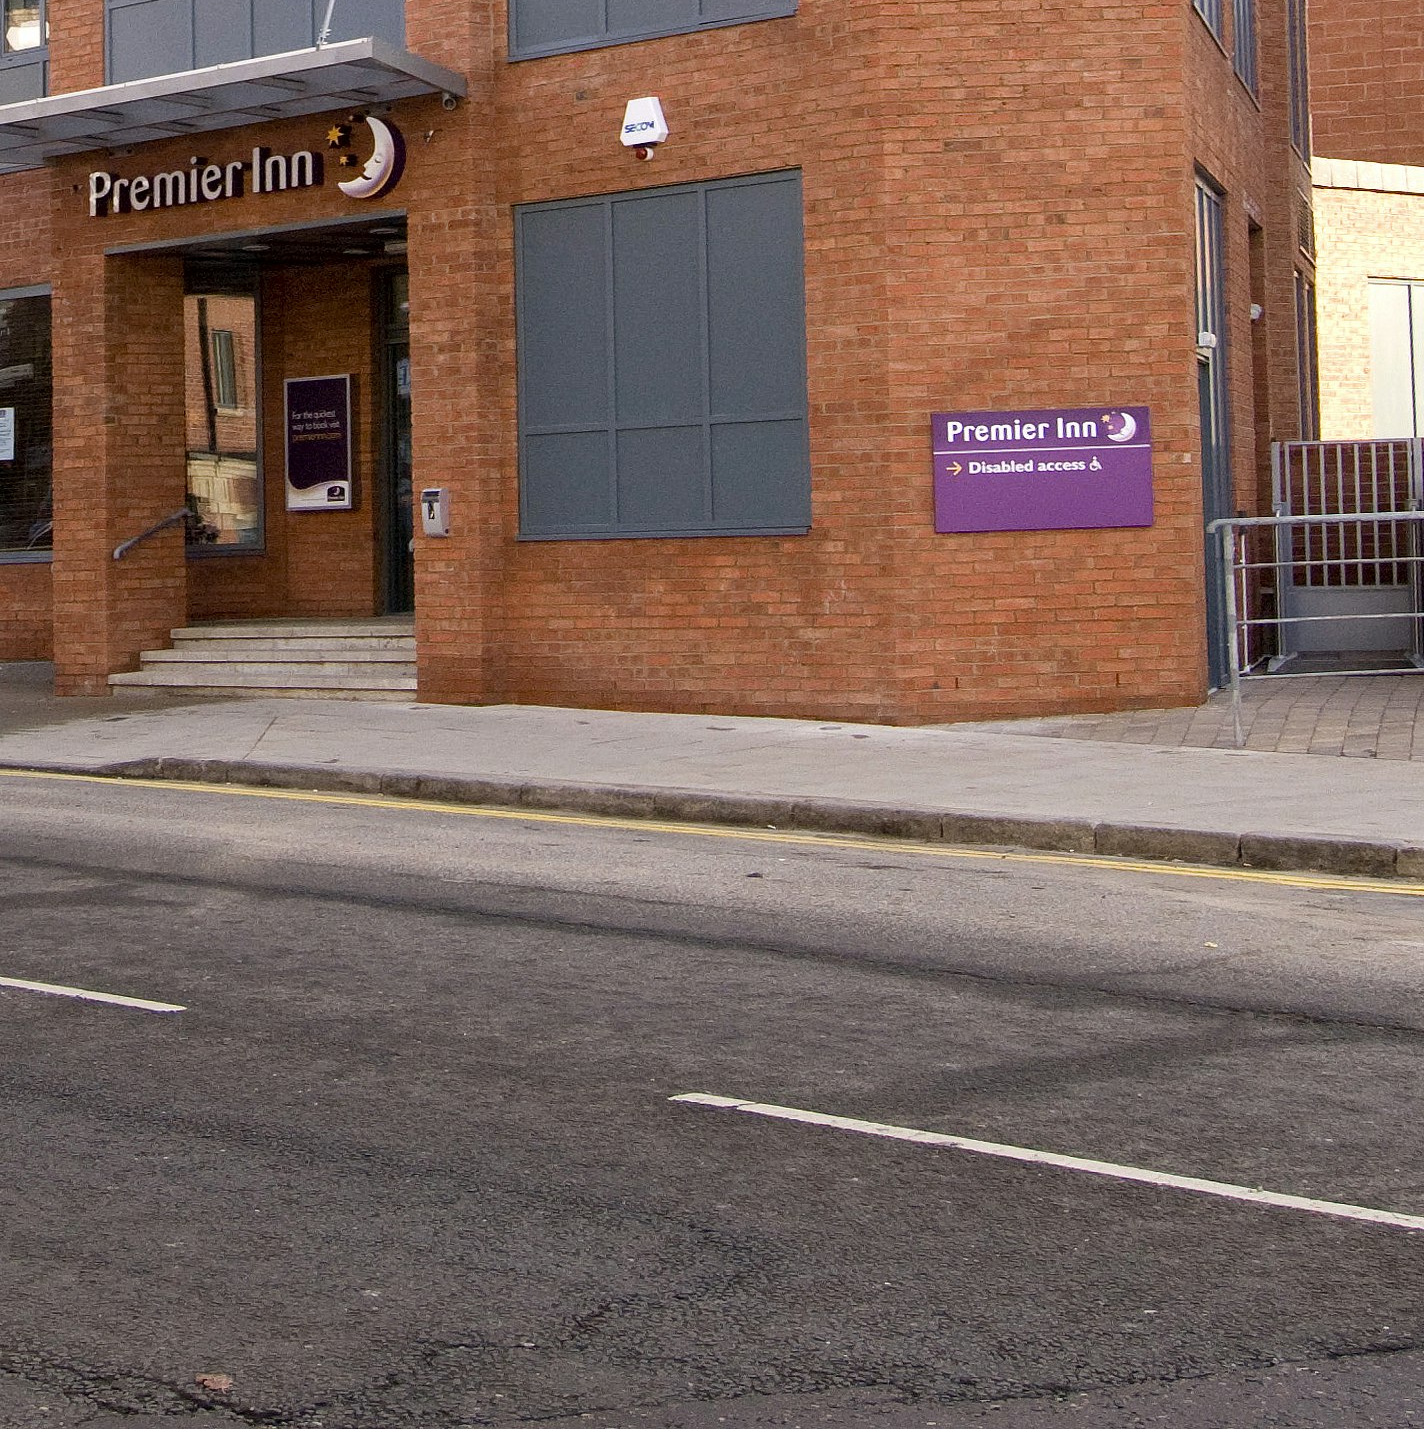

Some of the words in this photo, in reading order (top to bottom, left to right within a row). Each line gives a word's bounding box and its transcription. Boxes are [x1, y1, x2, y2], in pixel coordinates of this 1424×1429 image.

[624, 120, 655, 133] SECOM
[88, 156, 243, 217] Premier
[252, 147, 314, 193] Inn
[946, 419, 1050, 443] Premier
[1056, 417, 1098, 439] Inn
[968, 460, 1034, 475] Disabled
[1037, 461, 1086, 472] access
